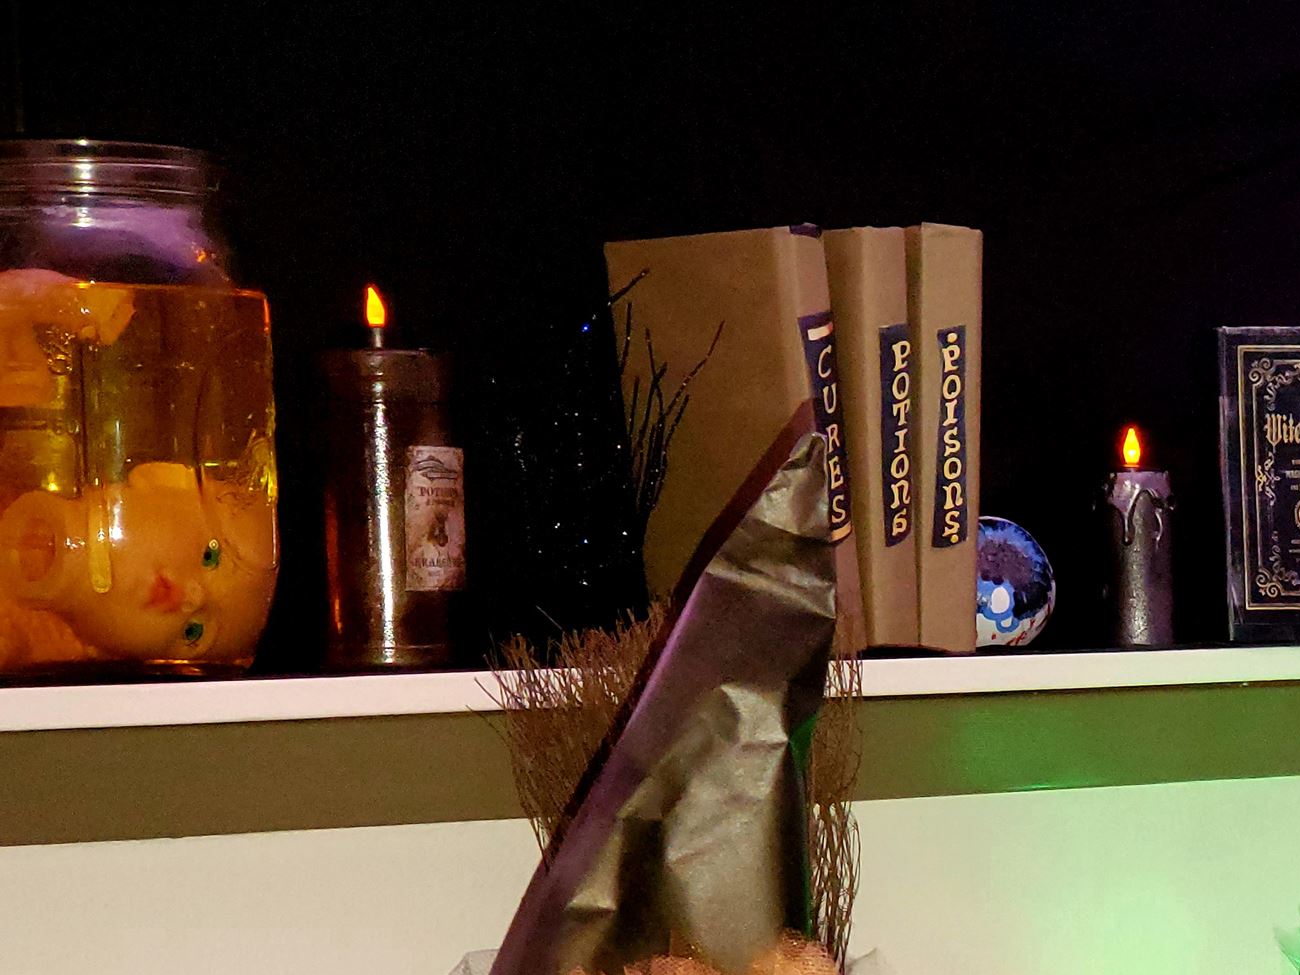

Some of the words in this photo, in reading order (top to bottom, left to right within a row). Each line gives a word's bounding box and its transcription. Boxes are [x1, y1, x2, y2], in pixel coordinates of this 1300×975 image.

[817, 344, 848, 523] CURES
[890, 340, 911, 537] POTIONS
[942, 343, 964, 541] POISONS
